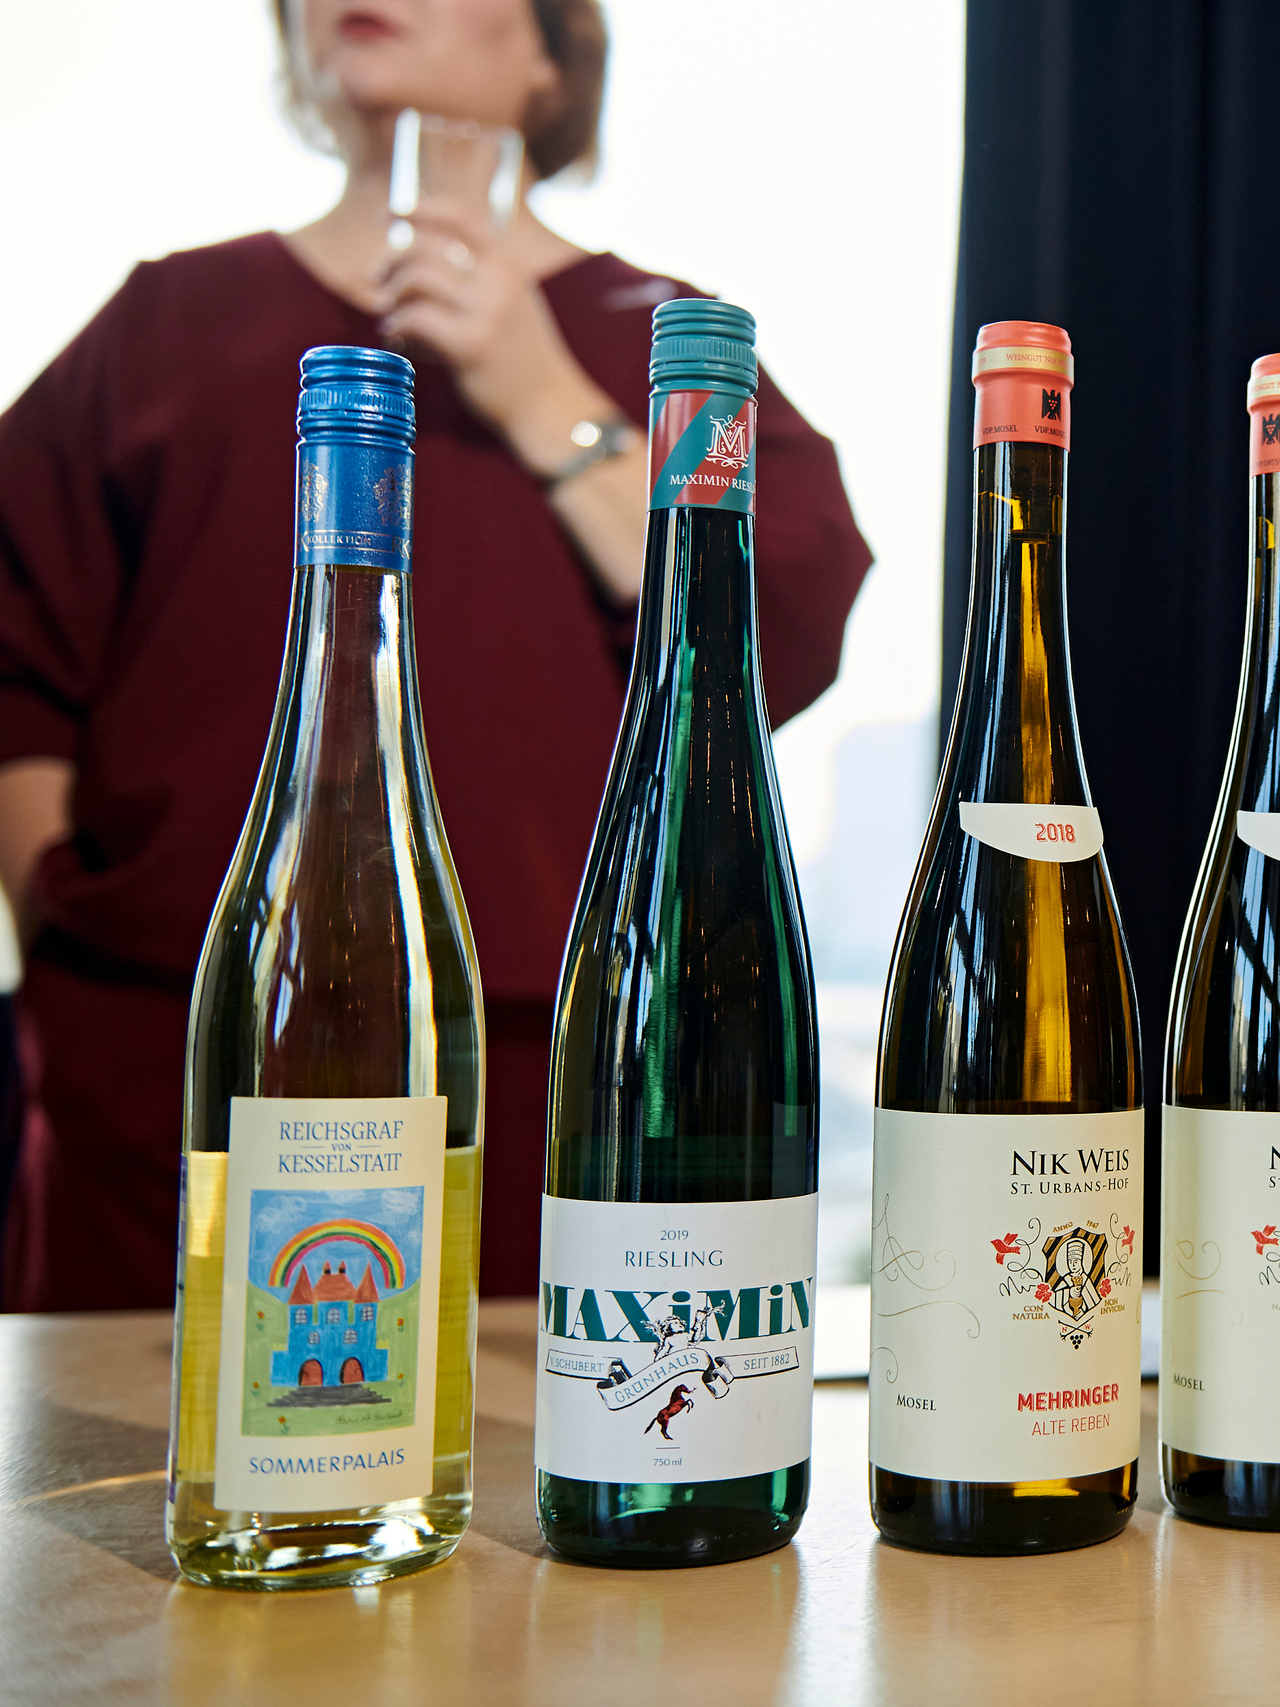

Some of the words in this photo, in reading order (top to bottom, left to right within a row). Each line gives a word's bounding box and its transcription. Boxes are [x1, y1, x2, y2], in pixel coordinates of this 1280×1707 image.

[1006, 353, 1043, 363] WEINGUT
[670, 474, 729, 487] MAXIMIN
[1035, 823, 1077, 844] 2018
[279, 1120, 404, 1141] REICHSGRAF
[331, 1143, 352, 1152] VON
[278, 1153, 403, 1174] KESSELSTATT
[1011, 1182, 1033, 1195] ST.
[1053, 1221, 1073, 1233] ANNO
[1086, 1219, 1100, 1229] 1947
[660, 1230, 689, 1241] 2019
[625, 1250, 723, 1268] RIESLING
[1100, 1304, 1125, 1315] INVICEM
[1104, 1298, 1119, 1306] NON
[743, 1356, 767, 1371] SEIT
[770, 1353, 790, 1368] 1882
[615, 1352, 700, 1404] GRÜNHAUS
[1173, 1373, 1205, 1392] MOSEL
[896, 1393, 937, 1411] MOSEL
[1017, 1383, 1120, 1413] MEHRINGER
[1031, 1418, 1067, 1436] ALTE
[1071, 1413, 1111, 1433] REBEN
[249, 1448, 406, 1474] SOMMERPALAIS
[653, 1458, 671, 1467] 750
[672, 1458, 682, 1466] ml
